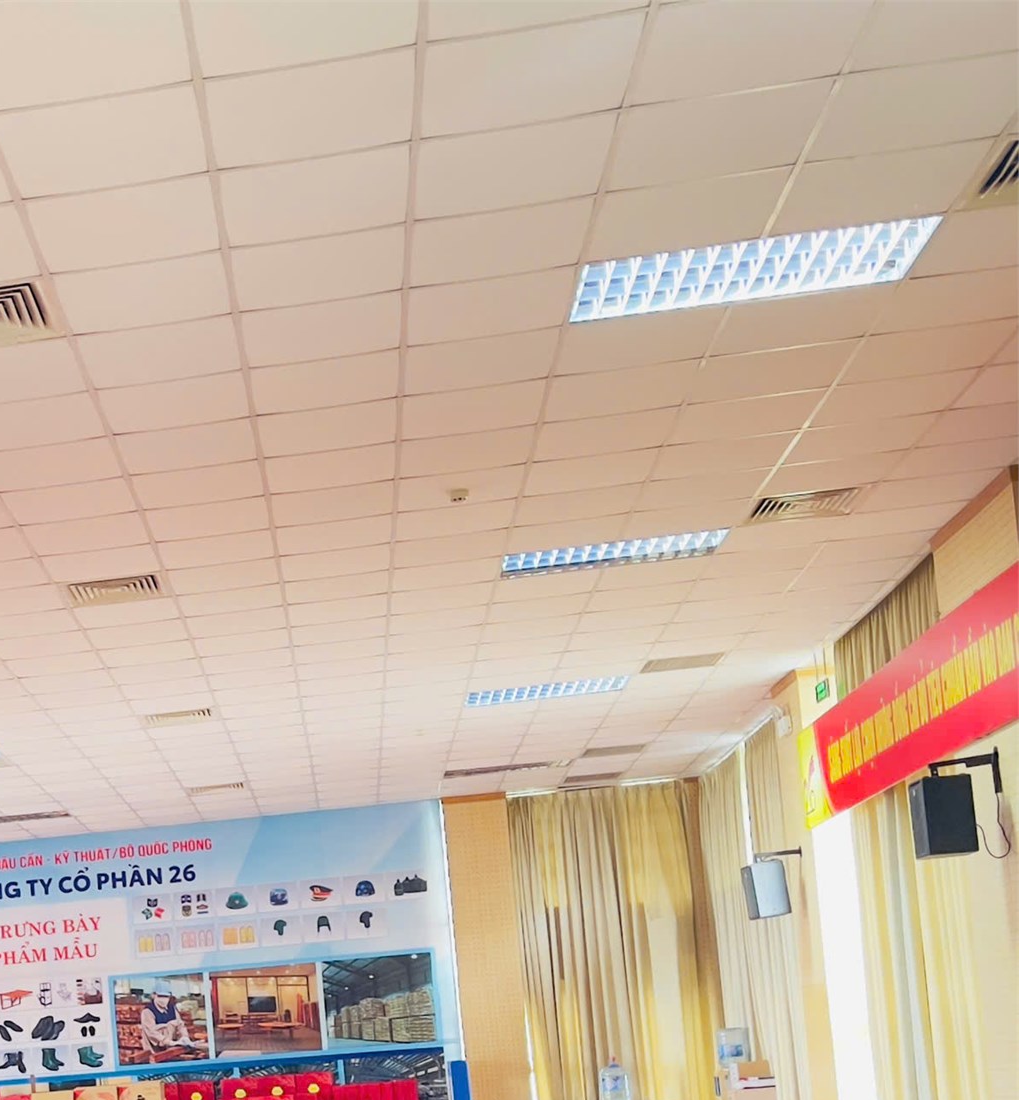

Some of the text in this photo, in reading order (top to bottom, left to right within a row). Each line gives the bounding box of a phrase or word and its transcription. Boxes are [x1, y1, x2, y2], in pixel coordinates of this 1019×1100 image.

[26, 877, 53, 897] TY
[58, 867, 91, 894] CỔ
[97, 863, 163, 890] PHẦN
[169, 864, 197, 884] 26
[54, 937, 98, 961] MẪU
